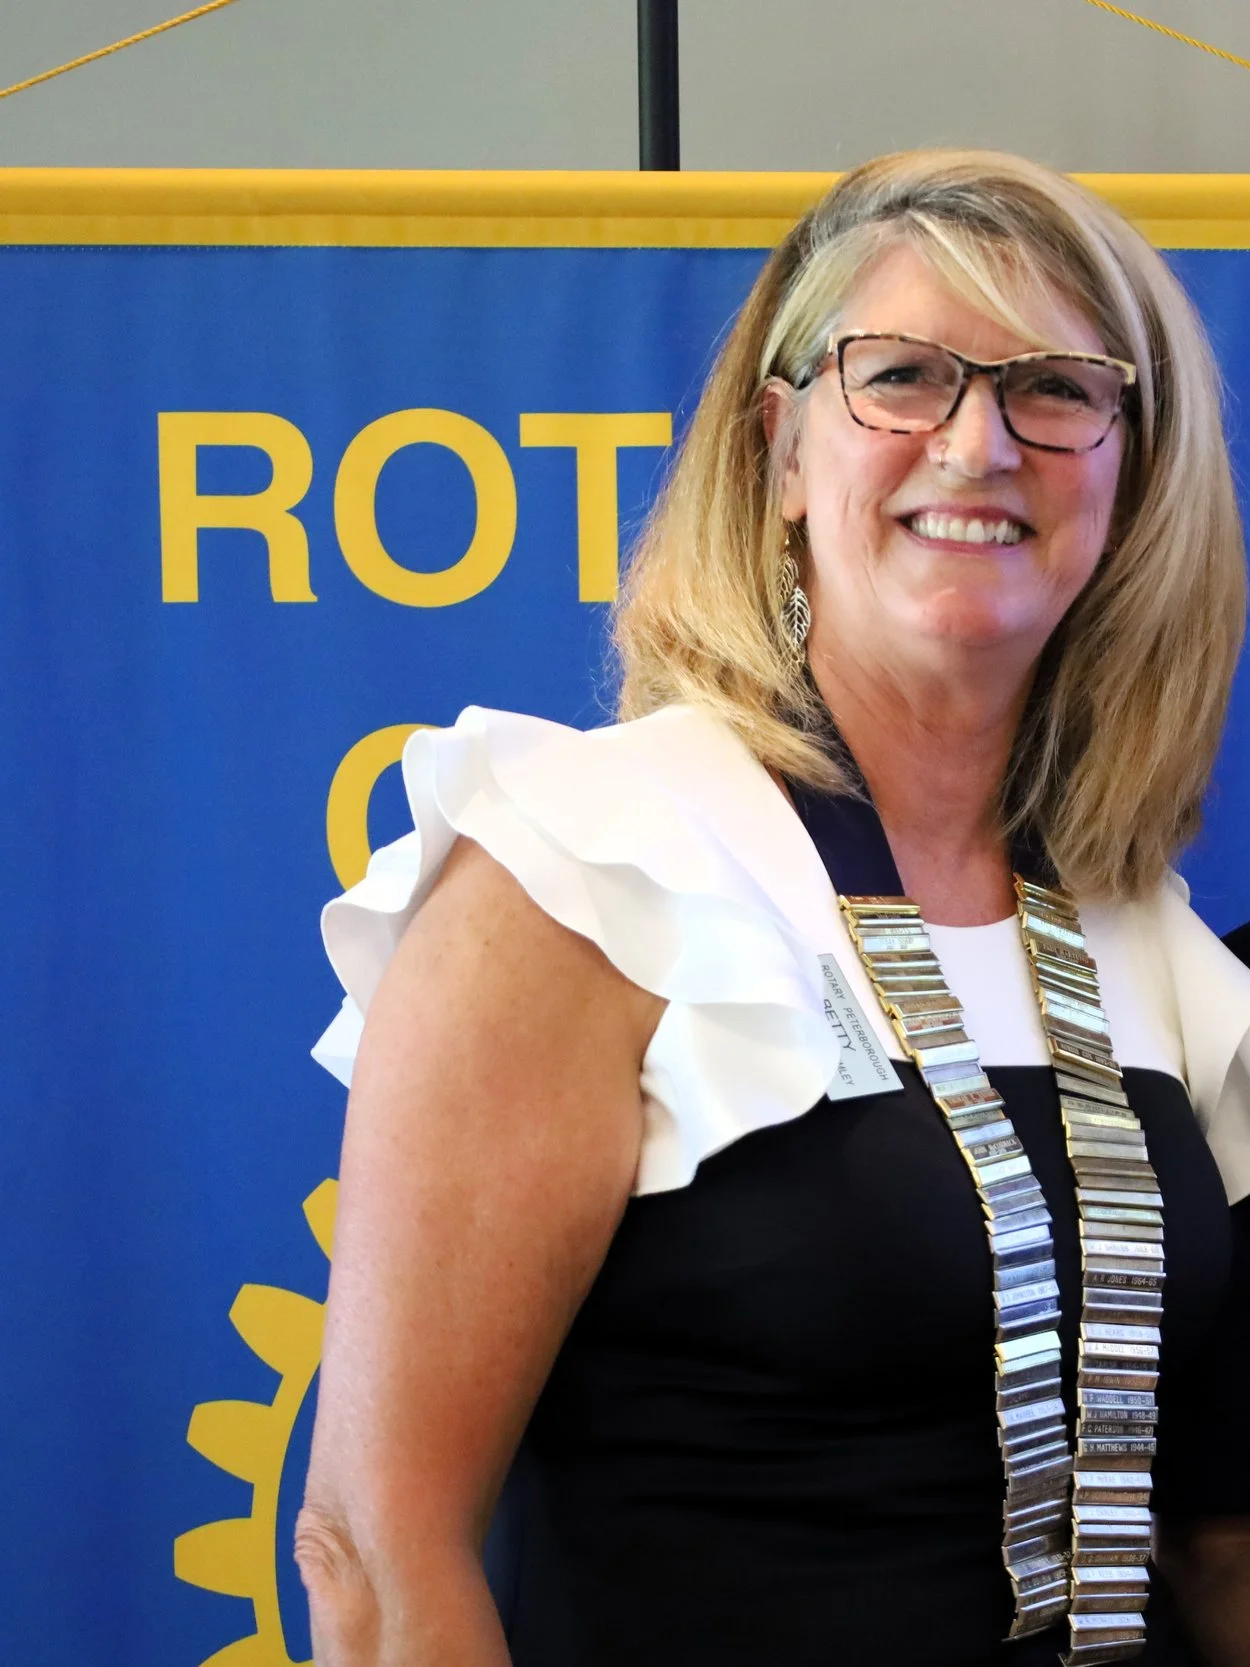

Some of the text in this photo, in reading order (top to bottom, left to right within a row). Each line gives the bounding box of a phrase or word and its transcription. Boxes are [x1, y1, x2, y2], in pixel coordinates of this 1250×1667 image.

[821, 964, 889, 1082] ROTARY PETERBOROUGH
[823, 998, 857, 1052] BETTY
[1100, 1410, 1128, 1420] HAMILTON
[1096, 1443, 1128, 1452] MATTHEWS
